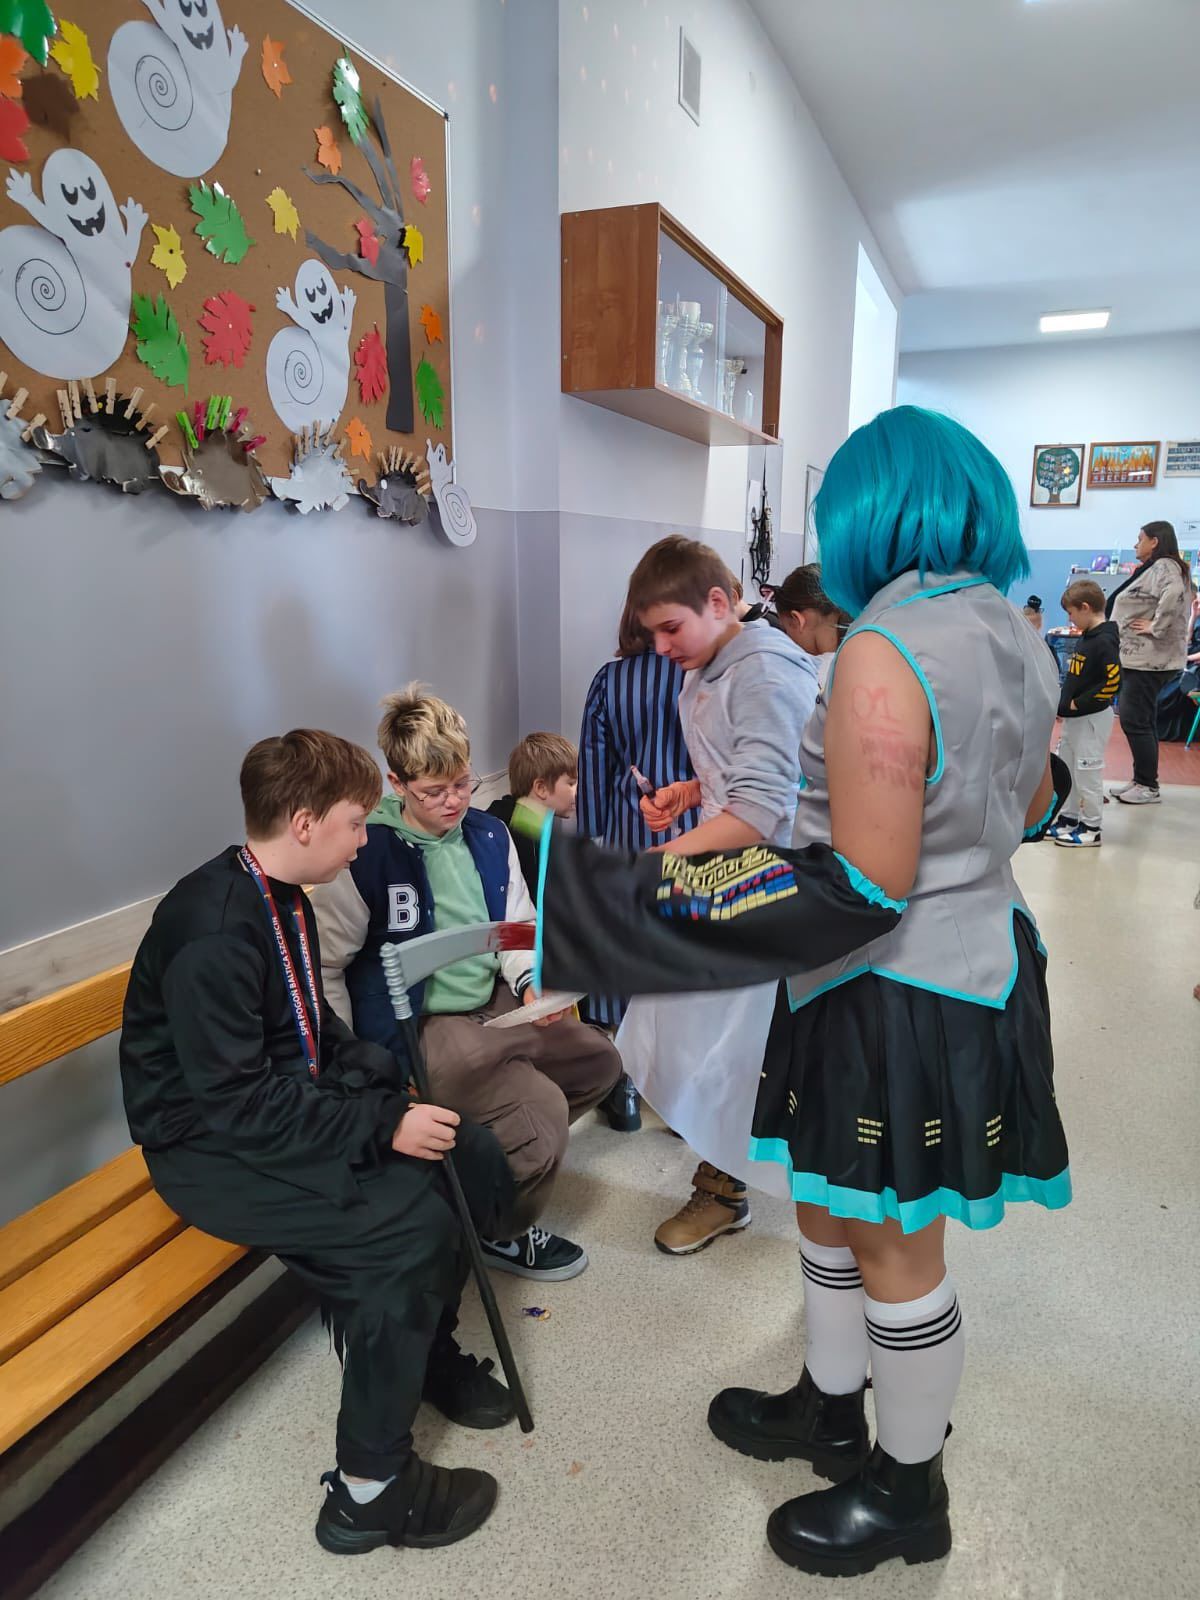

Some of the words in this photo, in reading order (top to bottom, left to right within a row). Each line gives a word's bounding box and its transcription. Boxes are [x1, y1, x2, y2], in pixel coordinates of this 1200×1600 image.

[387, 883, 420, 932] B
[272, 916, 287, 955] SZCZECIN
[282, 955, 297, 989] BALTICA
[298, 1020, 309, 1036] SPR
